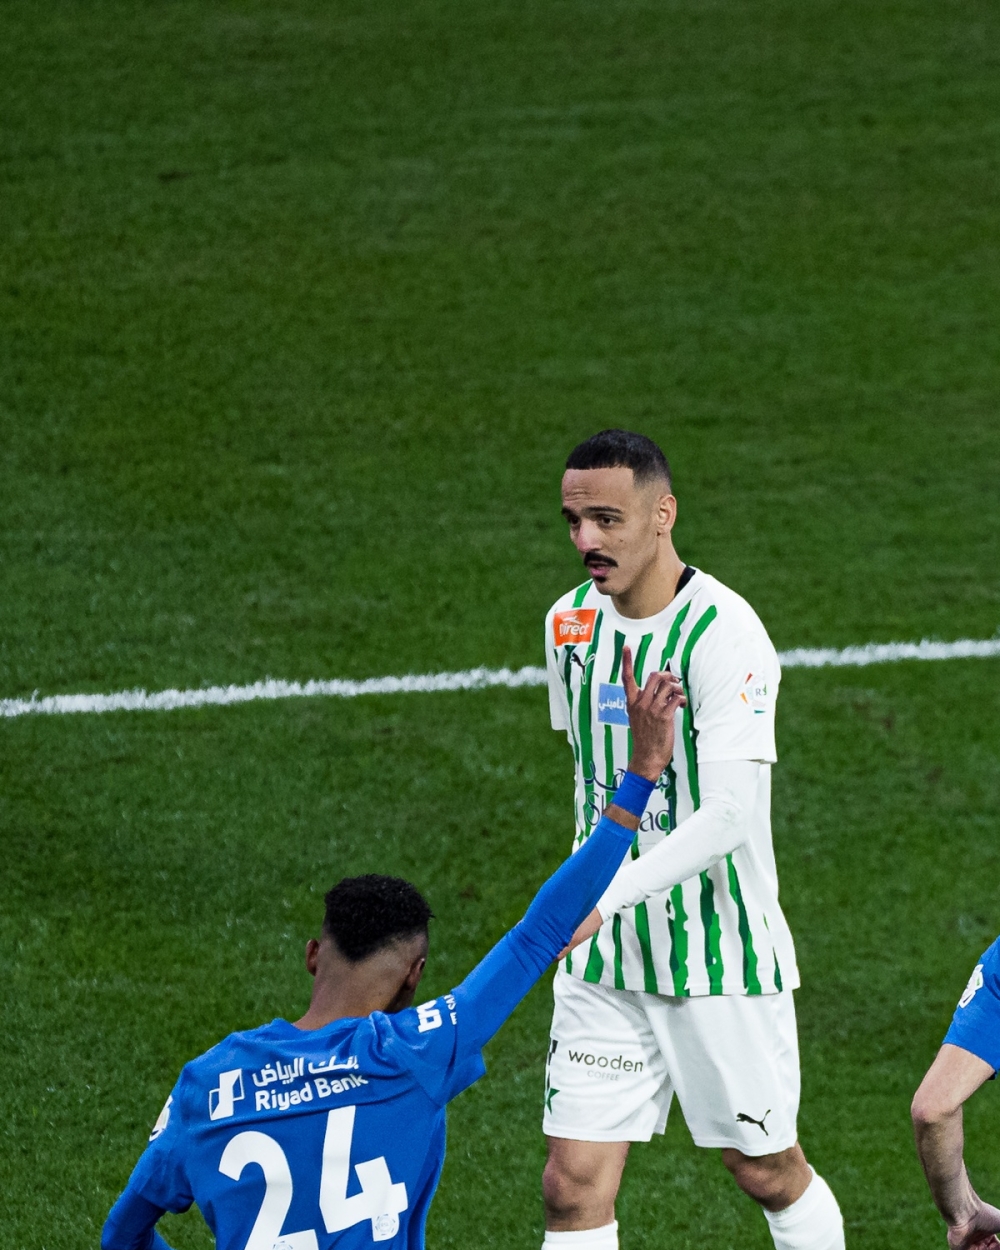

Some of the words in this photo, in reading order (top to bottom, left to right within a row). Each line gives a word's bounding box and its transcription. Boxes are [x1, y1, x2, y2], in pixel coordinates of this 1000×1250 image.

[252, 1057, 304, 1087] الرياض
[568, 1050, 644, 1073] wooden
[587, 1069, 620, 1081] COFFEE
[255, 1082, 314, 1112] Riyad
[313, 1073, 369, 1099] Bank
